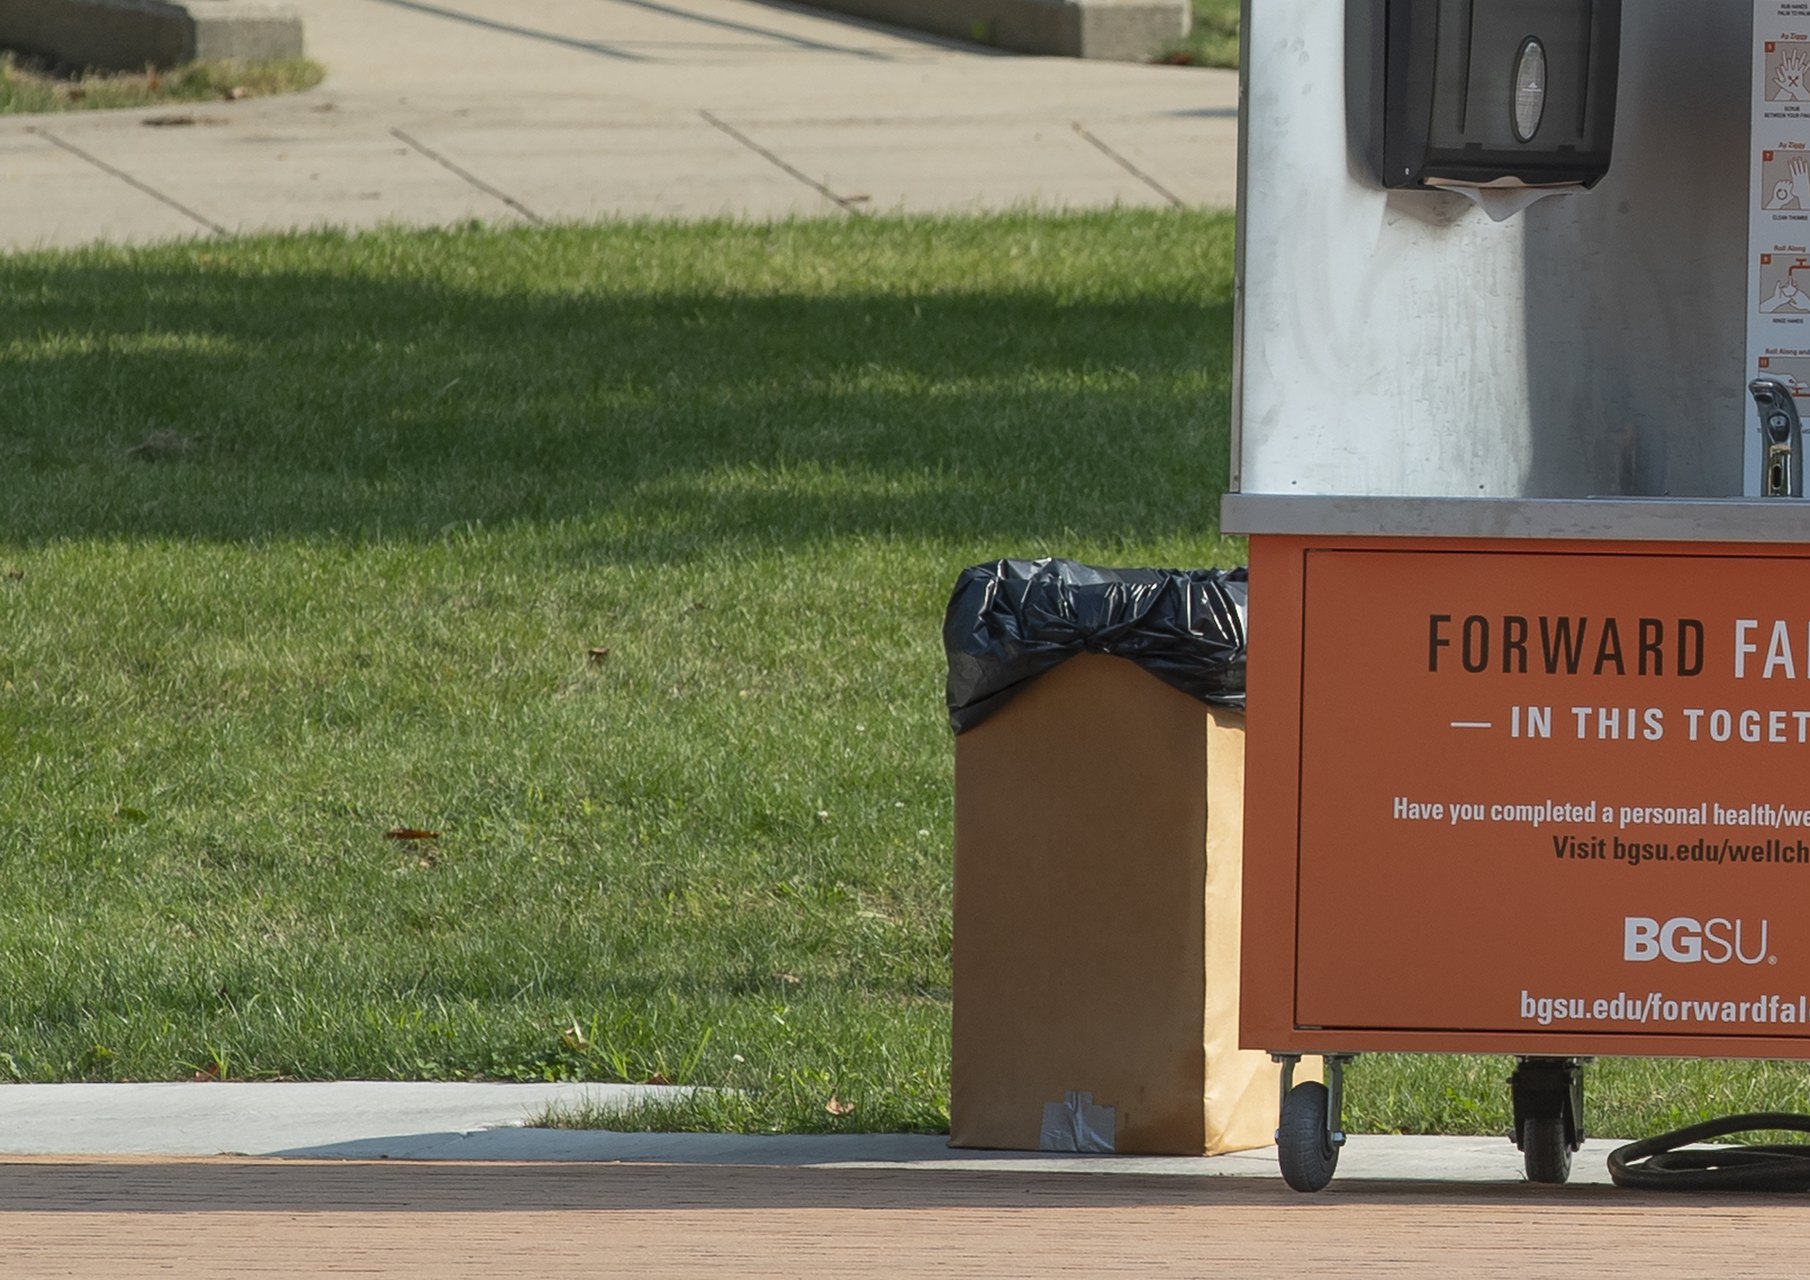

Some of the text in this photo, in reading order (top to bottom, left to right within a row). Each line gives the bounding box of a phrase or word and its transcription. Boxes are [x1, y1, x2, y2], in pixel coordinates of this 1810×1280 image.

[1428, 614, 1705, 677] FORWARD
[1510, 706, 1552, 739] IN
[1572, 706, 1664, 742] THIS
[1393, 797, 1443, 821] Have
[1449, 803, 1485, 827] you
[1491, 800, 1596, 827] completed
[1602, 806, 1614, 824] a
[1620, 802, 1708, 829] personal
[1553, 835, 1606, 860] Visit
